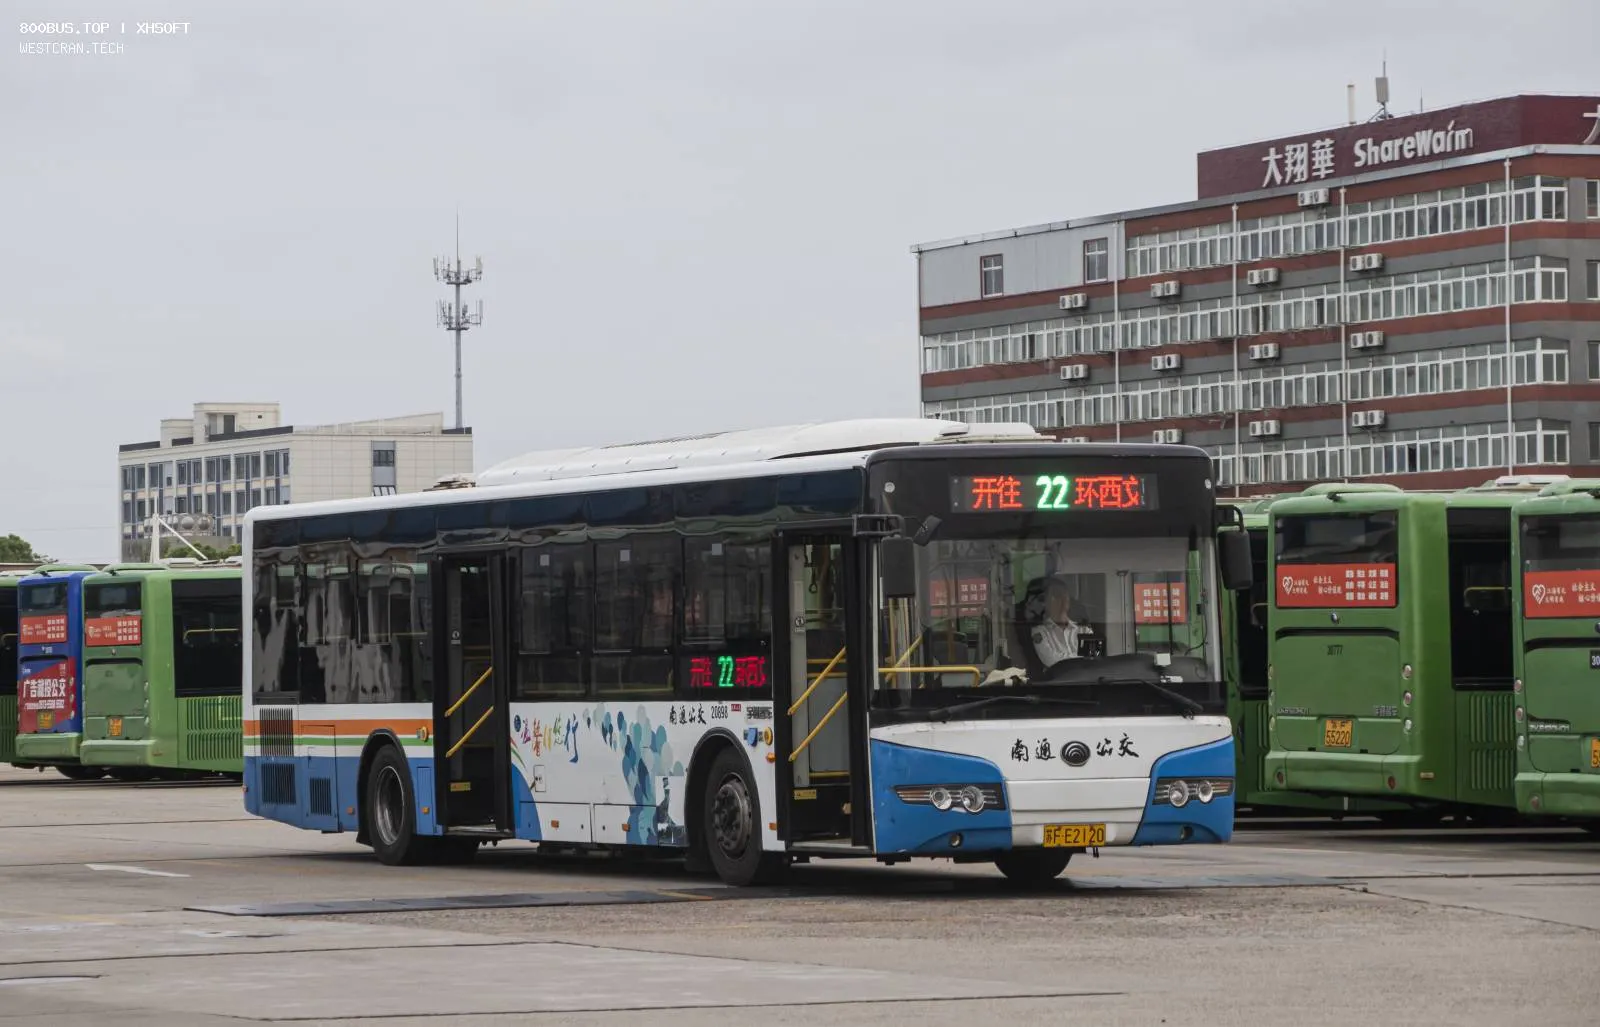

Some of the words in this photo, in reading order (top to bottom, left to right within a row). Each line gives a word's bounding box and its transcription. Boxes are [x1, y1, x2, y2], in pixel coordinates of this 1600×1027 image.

[1261, 139, 1336, 188] 大翔華
[972, 476, 1023, 509] 开往
[1036, 475, 1070, 509] 22
[718, 656, 734, 687] 22
[669, 703, 707, 725] 南通公交
[1011, 738, 1056, 762] 南通
[1096, 732, 1140, 758] 公交
[1326, 730, 1350, 745] 55220
